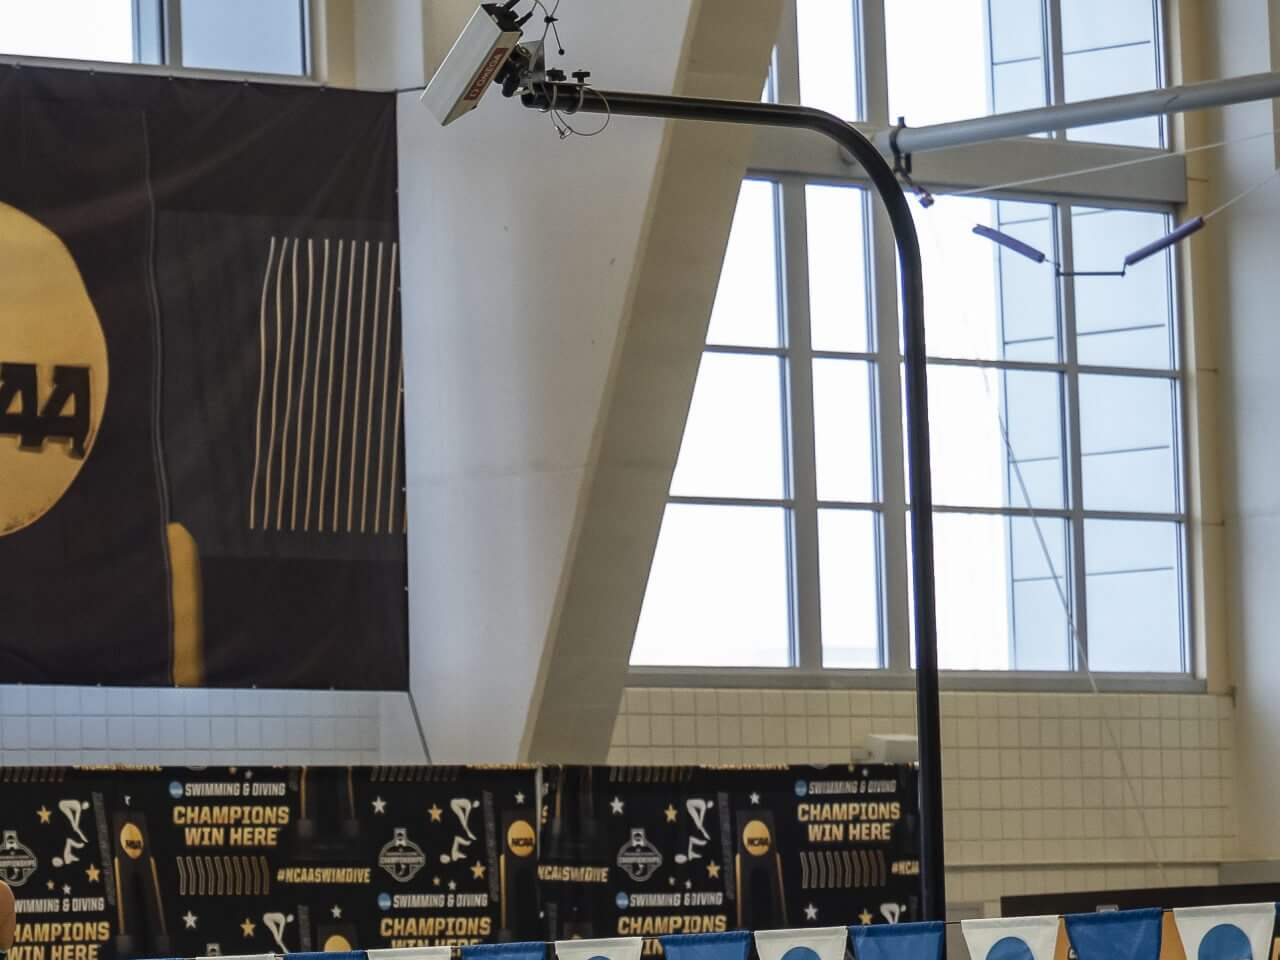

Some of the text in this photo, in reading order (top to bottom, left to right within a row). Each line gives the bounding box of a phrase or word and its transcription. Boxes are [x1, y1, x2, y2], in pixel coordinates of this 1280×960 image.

[185, 782, 286, 797] SWIMMING & DIVING
[808, 780, 857, 795] SWIMMING
[173, 805, 290, 825] CHAMPIONS
[797, 802, 901, 821] CHAMPIONS
[185, 827, 278, 846] WIN HERE
[808, 822, 891, 842] WIN HERE
[277, 867, 371, 884] #NCAASWIMDIVE
[14, 898, 60, 912] WIMMING
[72, 897, 105, 911] DIVING
[392, 894, 445, 908] SWIMMING
[456, 893, 488, 907] DIVING
[629, 893, 681, 907] SWIMMING
[13, 921, 110, 942] HAMPIONS
[380, 917, 492, 937] CHAMPIONS
[618, 915, 727, 935] CHAMPIONS
[642, 938, 664, 955] IN
